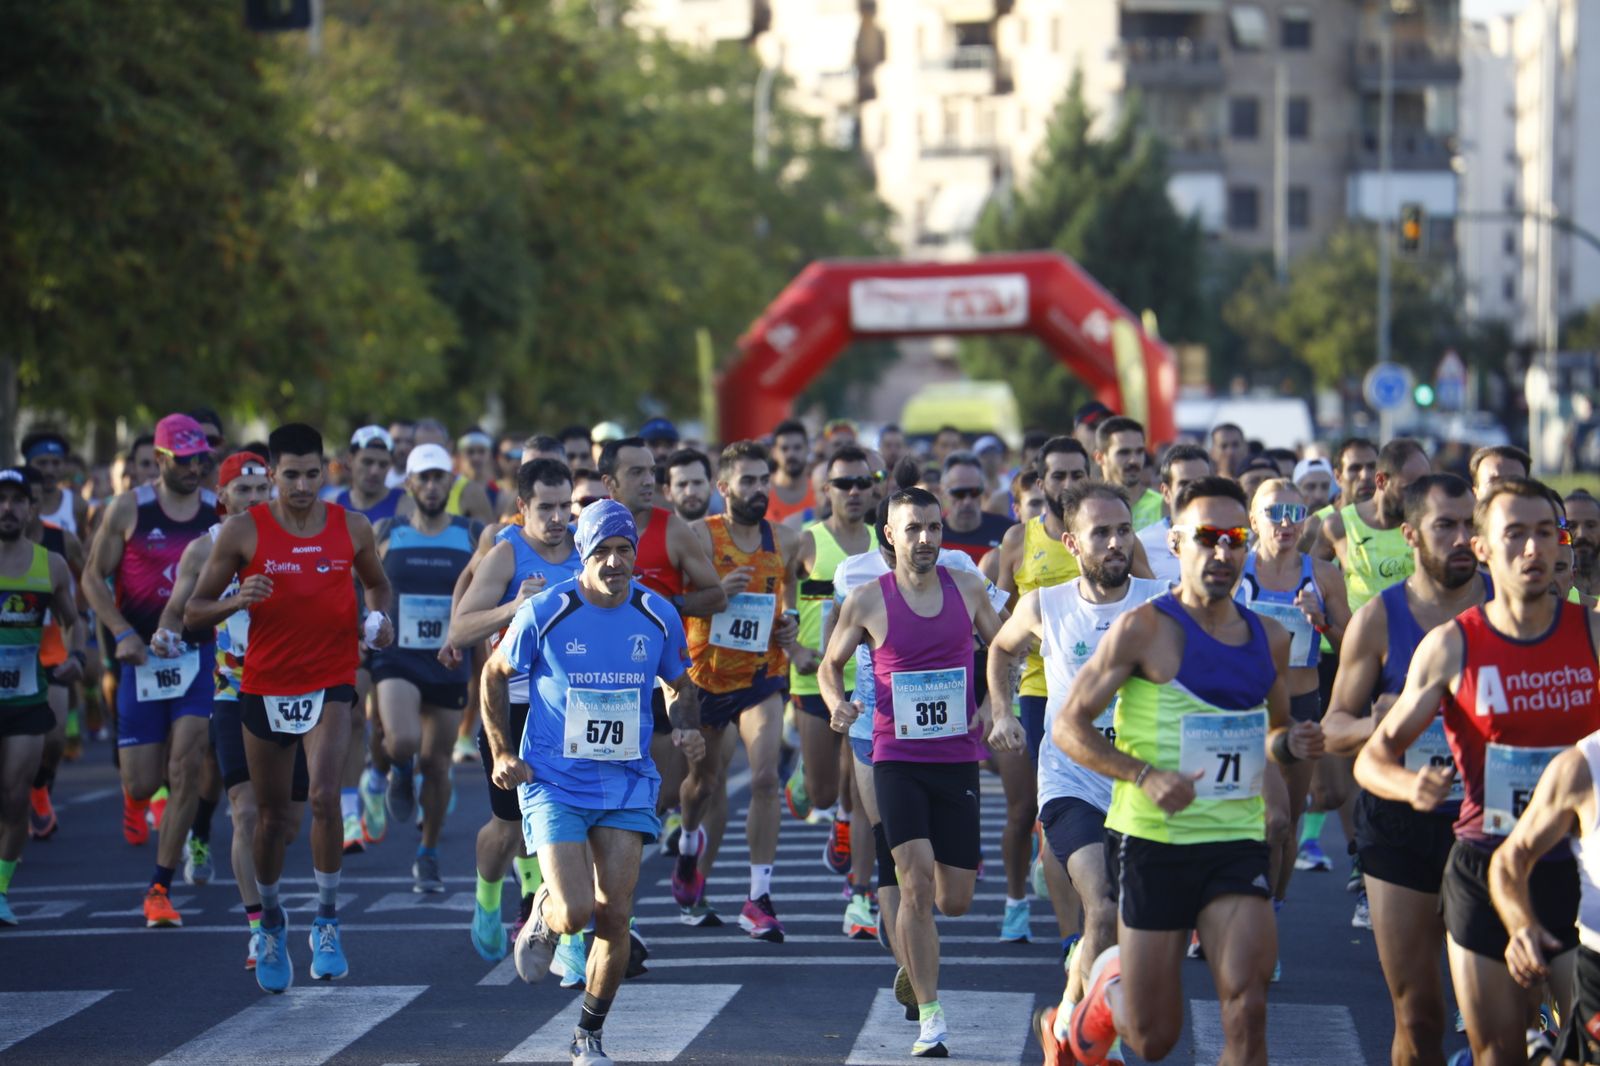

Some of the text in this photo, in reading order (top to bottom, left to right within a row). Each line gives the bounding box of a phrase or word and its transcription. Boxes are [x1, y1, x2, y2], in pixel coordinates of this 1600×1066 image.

[417, 620, 443, 638] 130
[729, 618, 759, 641] 481
[154, 667, 182, 689] 165
[567, 672, 646, 685] TROTASIERRA
[896, 684, 923, 693] MEDIA
[278, 699, 313, 722] 542
[915, 700, 948, 727] 313
[586, 719, 624, 746] 579
[1215, 753, 1241, 783] 71
